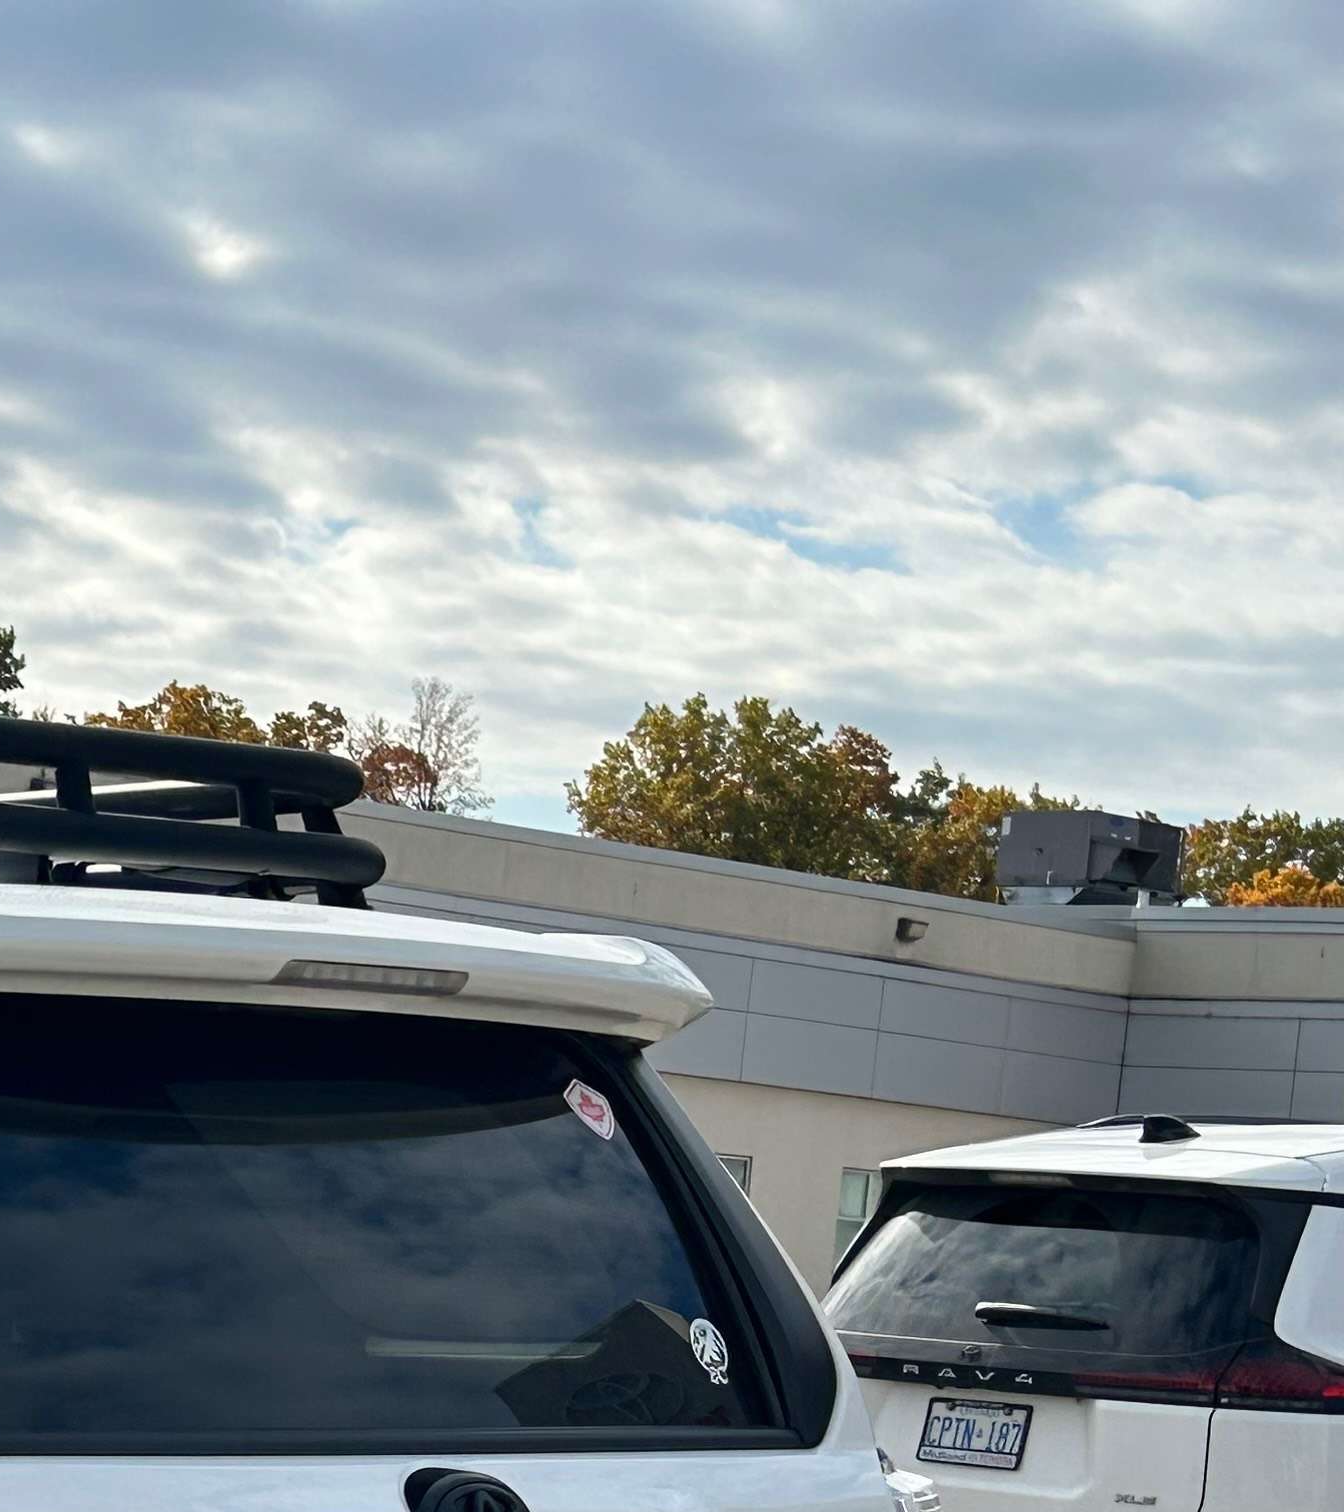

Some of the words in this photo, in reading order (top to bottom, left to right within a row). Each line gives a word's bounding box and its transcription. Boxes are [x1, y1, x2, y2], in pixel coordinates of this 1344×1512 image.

[903, 1364, 1032, 1384] RAV4
[926, 1415, 978, 1449] CPTN
[985, 1420, 1022, 1454] 187
